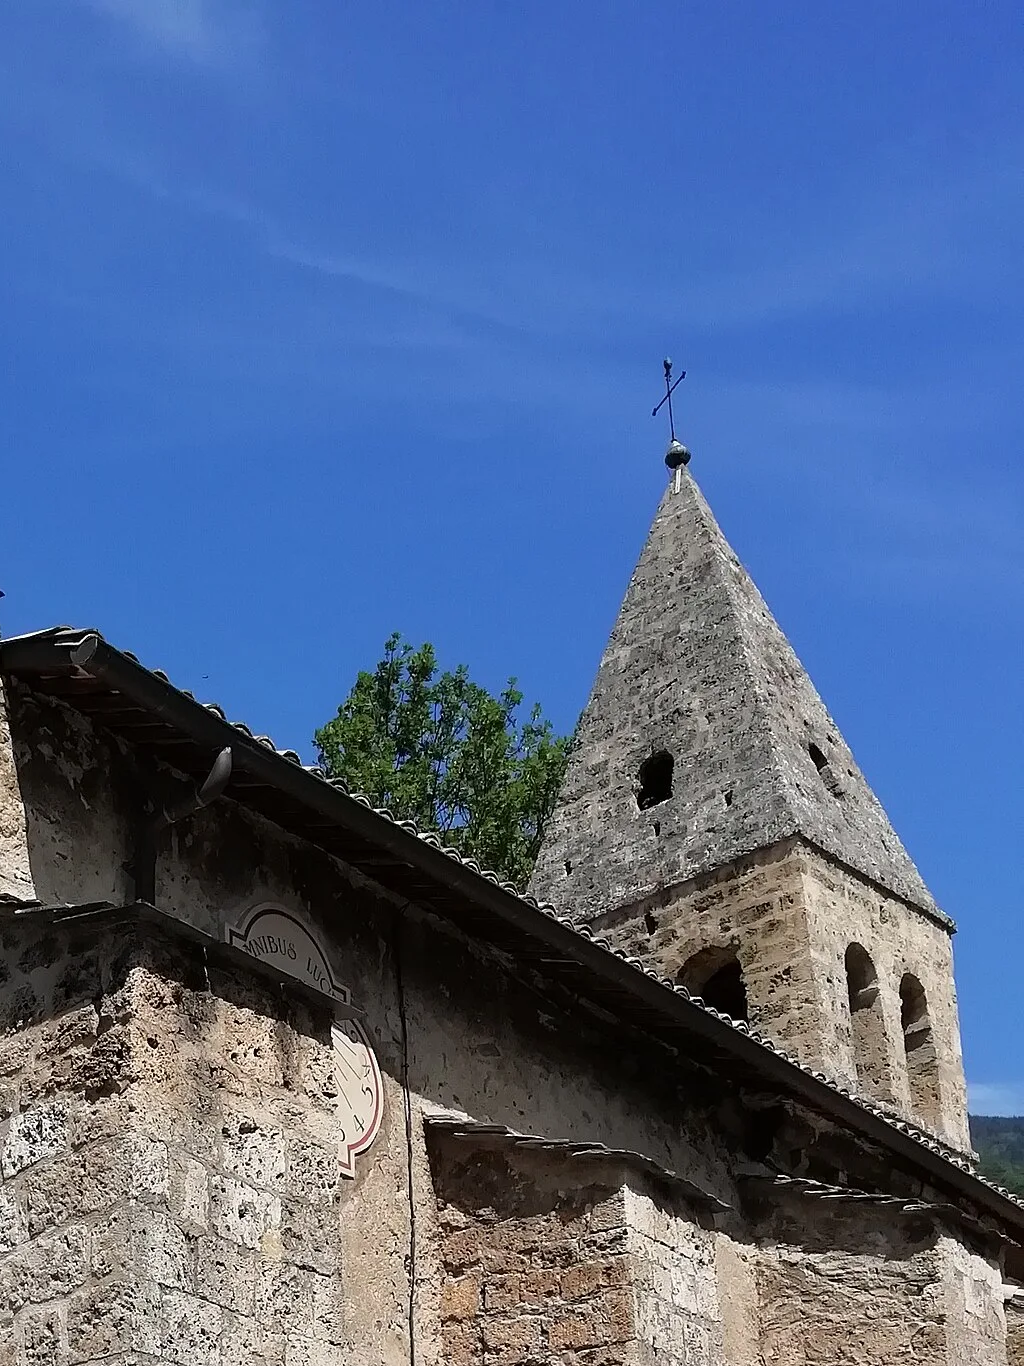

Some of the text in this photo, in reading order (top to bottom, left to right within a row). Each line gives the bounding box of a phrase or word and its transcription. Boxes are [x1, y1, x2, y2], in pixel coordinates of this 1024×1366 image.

[242, 935, 336, 997] MNIBUS LUC
[361, 1083, 374, 1108] 5
[352, 1113, 365, 1133] 4
